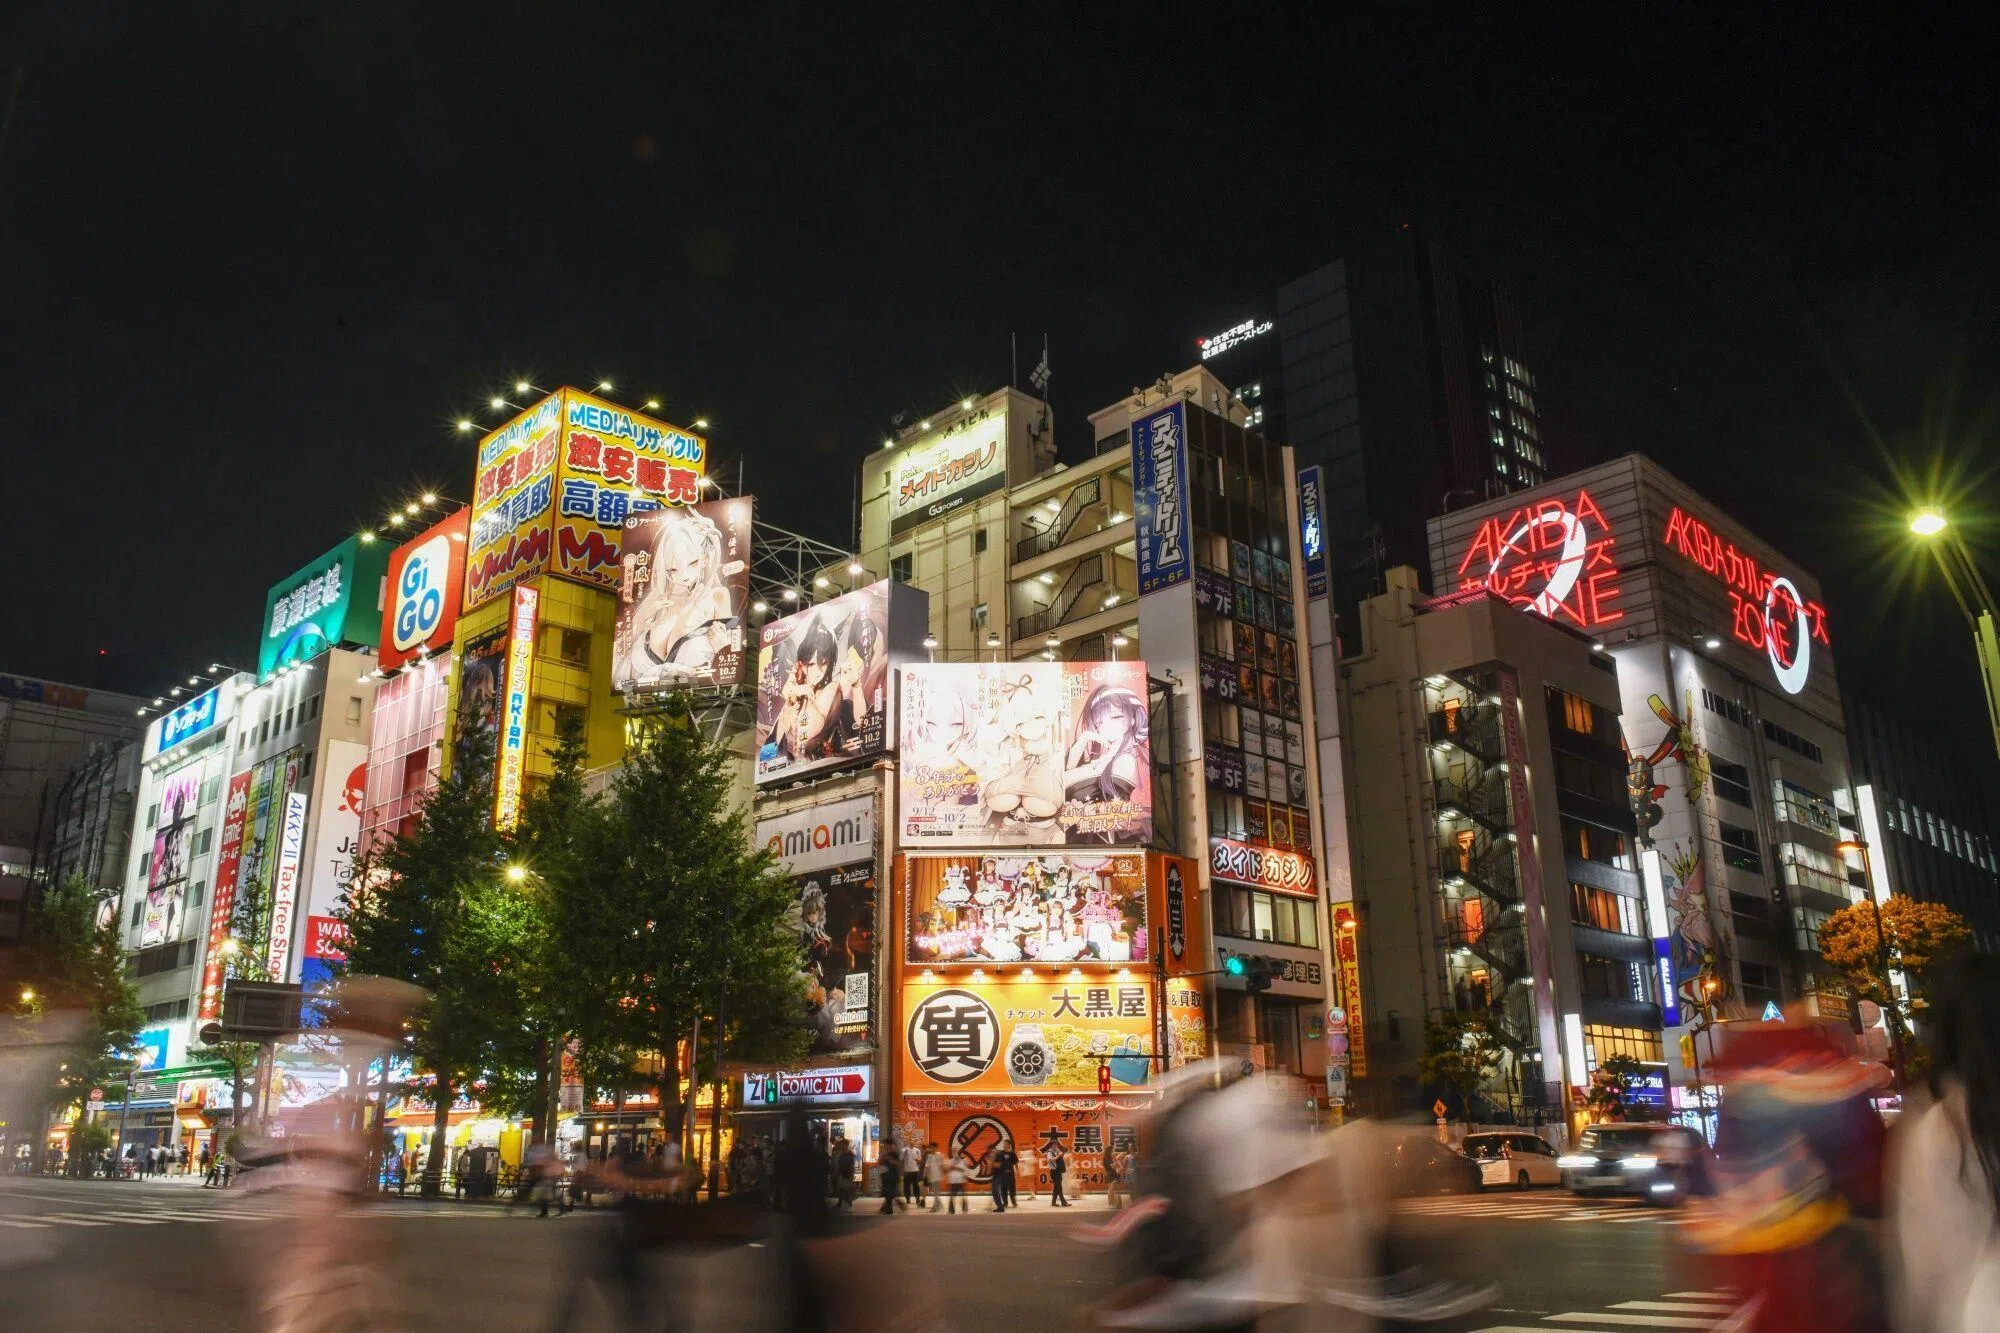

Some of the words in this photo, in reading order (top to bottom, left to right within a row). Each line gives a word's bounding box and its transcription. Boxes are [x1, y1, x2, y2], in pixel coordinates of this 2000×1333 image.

[568, 401, 701, 462] MEDIAリサイクル
[477, 428, 557, 505] 激安販売
[566, 431, 700, 506] 激安販売
[900, 441, 997, 506] メイドカジノ
[1151, 412, 1184, 569] アメニティドリーム
[1458, 489, 1611, 576] AKIBA
[1215, 593, 1232, 615] 7F
[719, 666, 737, 676] 10.2
[1219, 678, 1237, 699] 6F
[508, 693, 524, 749] AKIBA
[864, 732, 881, 744] 10.2
[923, 784, 981, 800] ありがとう
[1224, 768, 1243, 790] 5F
[286, 797, 303, 849] AKKY
[912, 806, 936, 817] 9/12
[767, 816, 861, 858] amiami
[1213, 844, 1314, 889] メイドカジノ
[275, 863, 297, 934] Tax-free
[1348, 967, 1359, 1000] TAX
[1006, 1009, 1046, 1020] チケット
[1051, 987, 1147, 1018] 大黒屋
[920, 1003, 988, 1072] 質
[1350, 1004, 1362, 1047] FREE
[747, 1078, 765, 1101] ZI
[781, 1079, 822, 1095] COMIC
[824, 1077, 844, 1093] ZIN
[1038, 1126, 1139, 1155] 大黒屋
